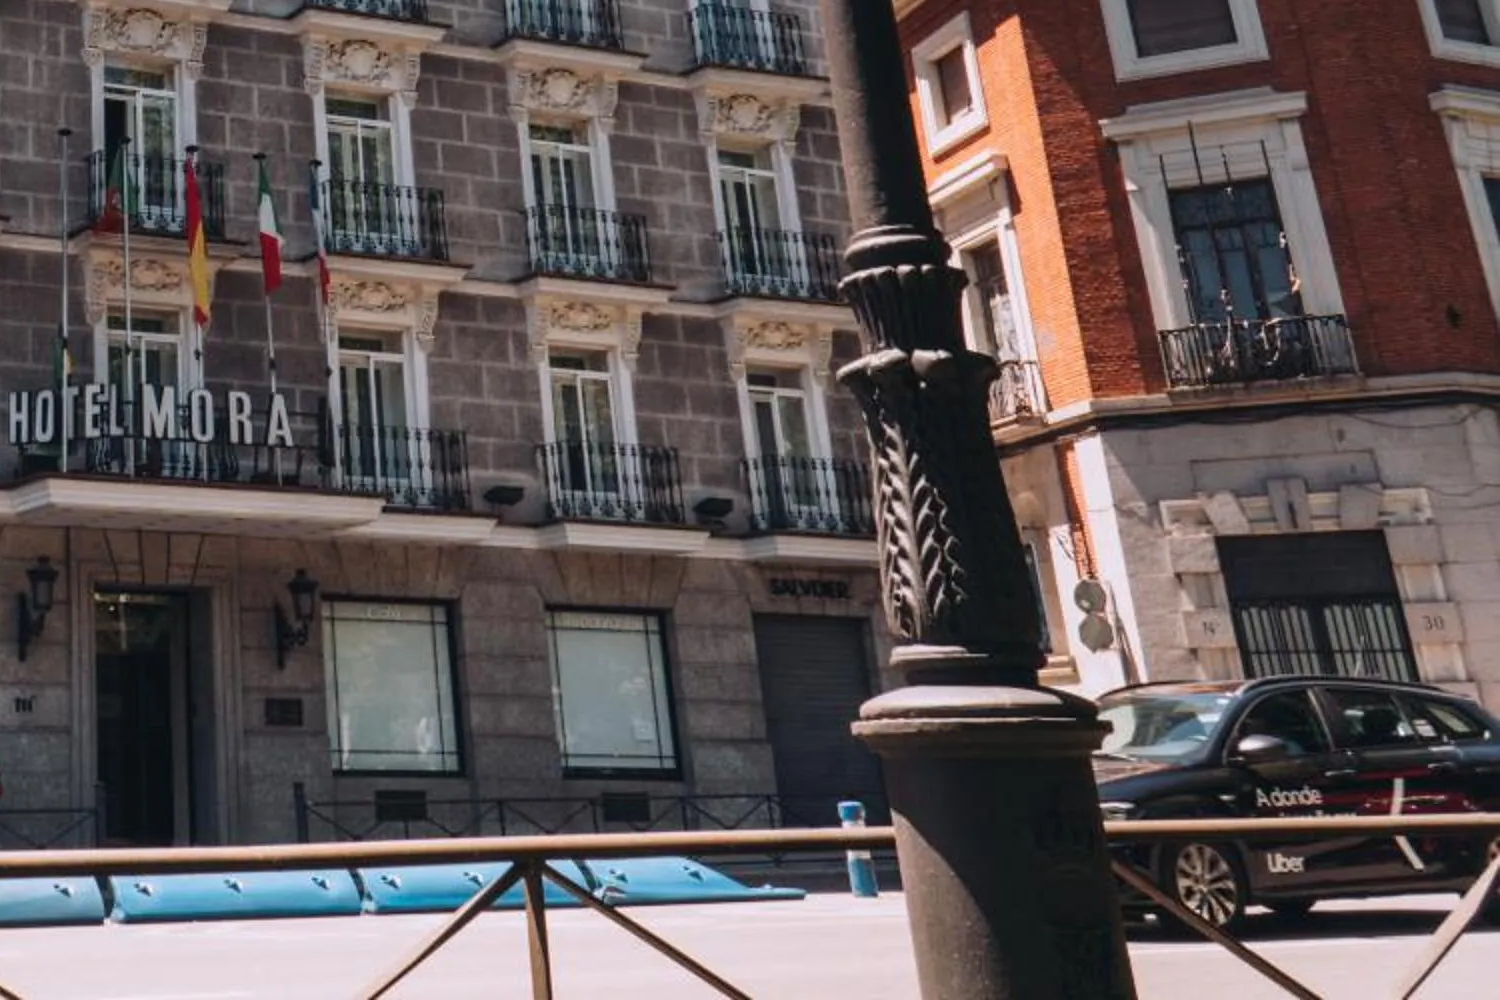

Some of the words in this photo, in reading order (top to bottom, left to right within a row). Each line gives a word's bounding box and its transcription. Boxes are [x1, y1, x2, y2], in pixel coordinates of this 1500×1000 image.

[8, 383, 125, 445] HOTEL
[141, 384, 294, 447] MORA
[1266, 852, 1305, 874] Uber
